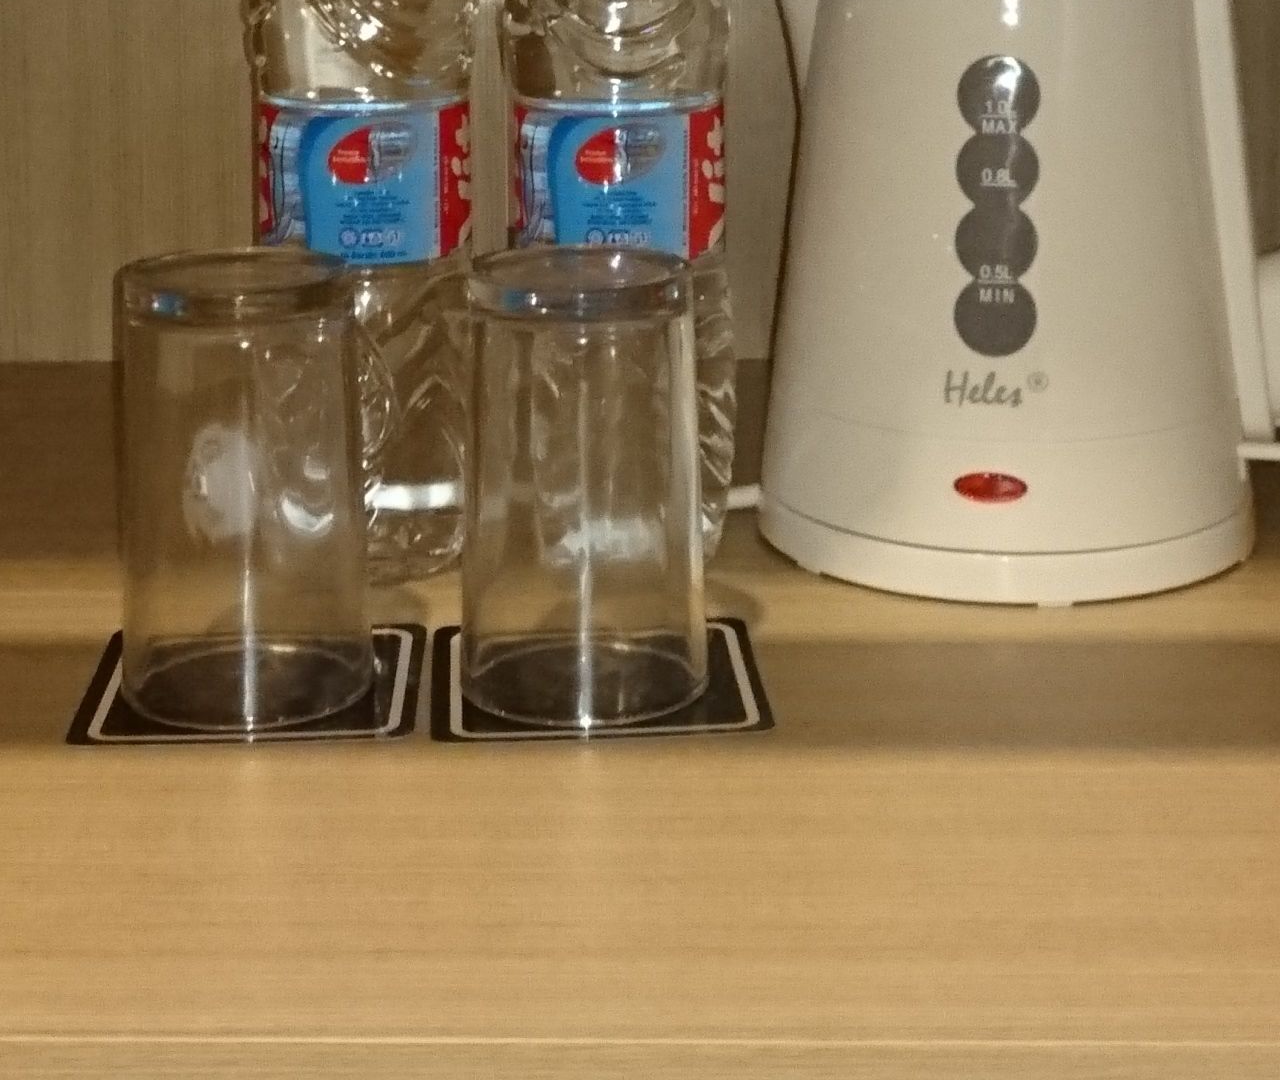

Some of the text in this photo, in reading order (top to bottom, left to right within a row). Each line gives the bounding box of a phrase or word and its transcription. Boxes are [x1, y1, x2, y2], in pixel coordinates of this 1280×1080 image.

[982, 119, 1018, 134] MAX
[979, 264, 1013, 280] 0.5L
[979, 287, 1015, 304] MIN
